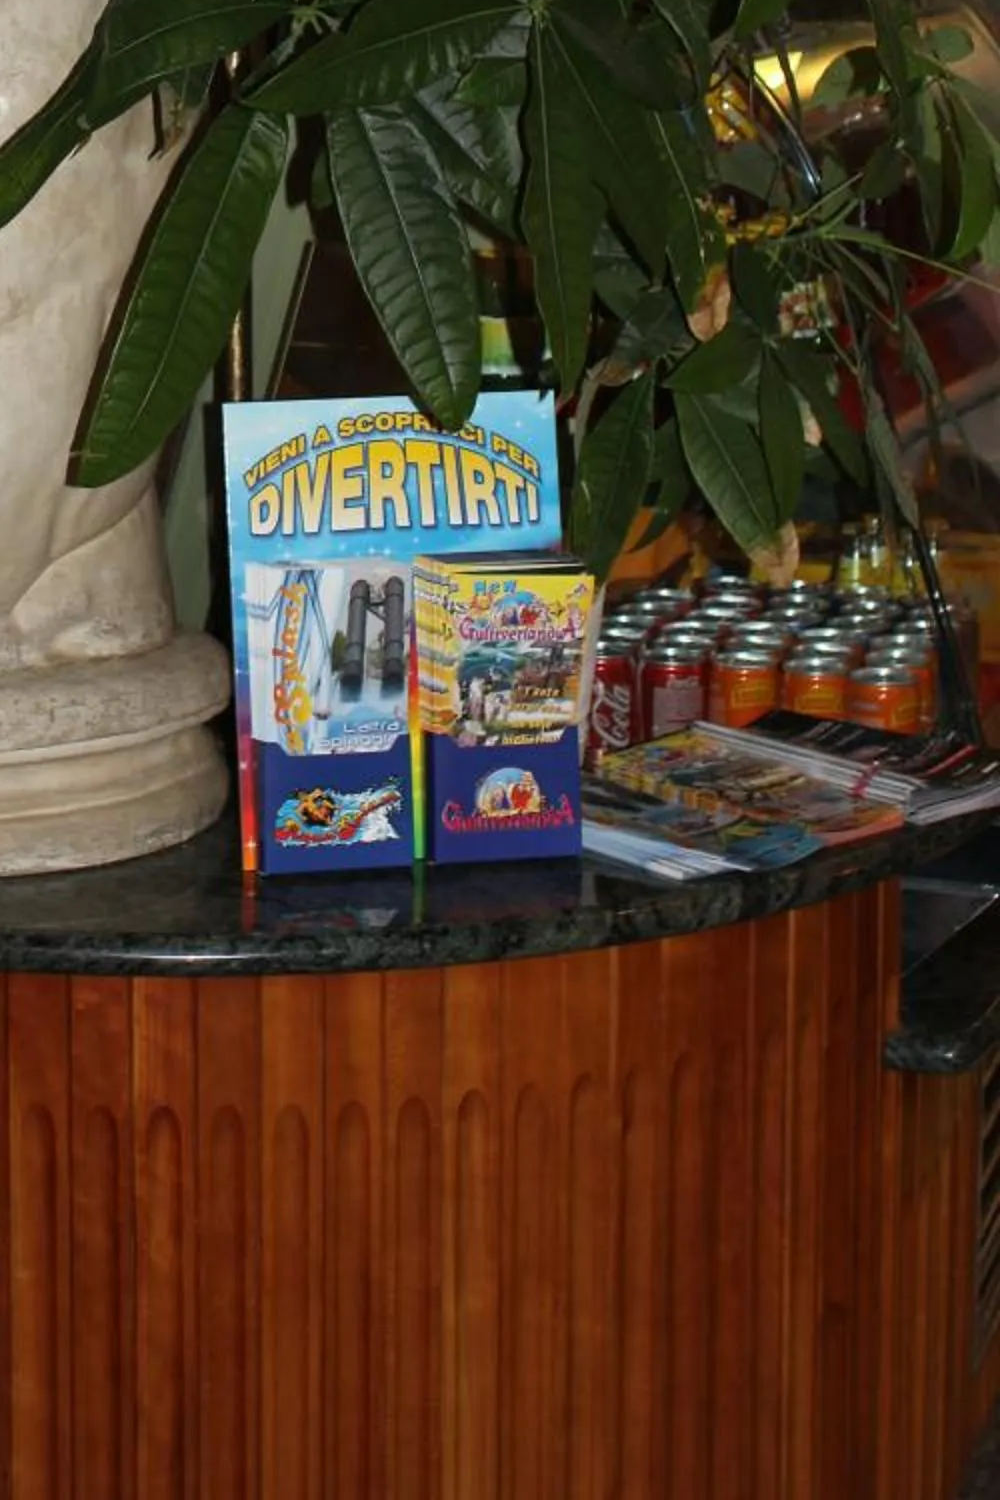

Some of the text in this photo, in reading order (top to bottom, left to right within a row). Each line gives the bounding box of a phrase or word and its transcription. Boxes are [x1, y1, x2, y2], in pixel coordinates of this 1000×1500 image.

[243, 435, 306, 488] VIENI
[311, 425, 334, 448] A
[490, 431, 540, 479] PER
[249, 438, 541, 537] DIVERTIRTI
